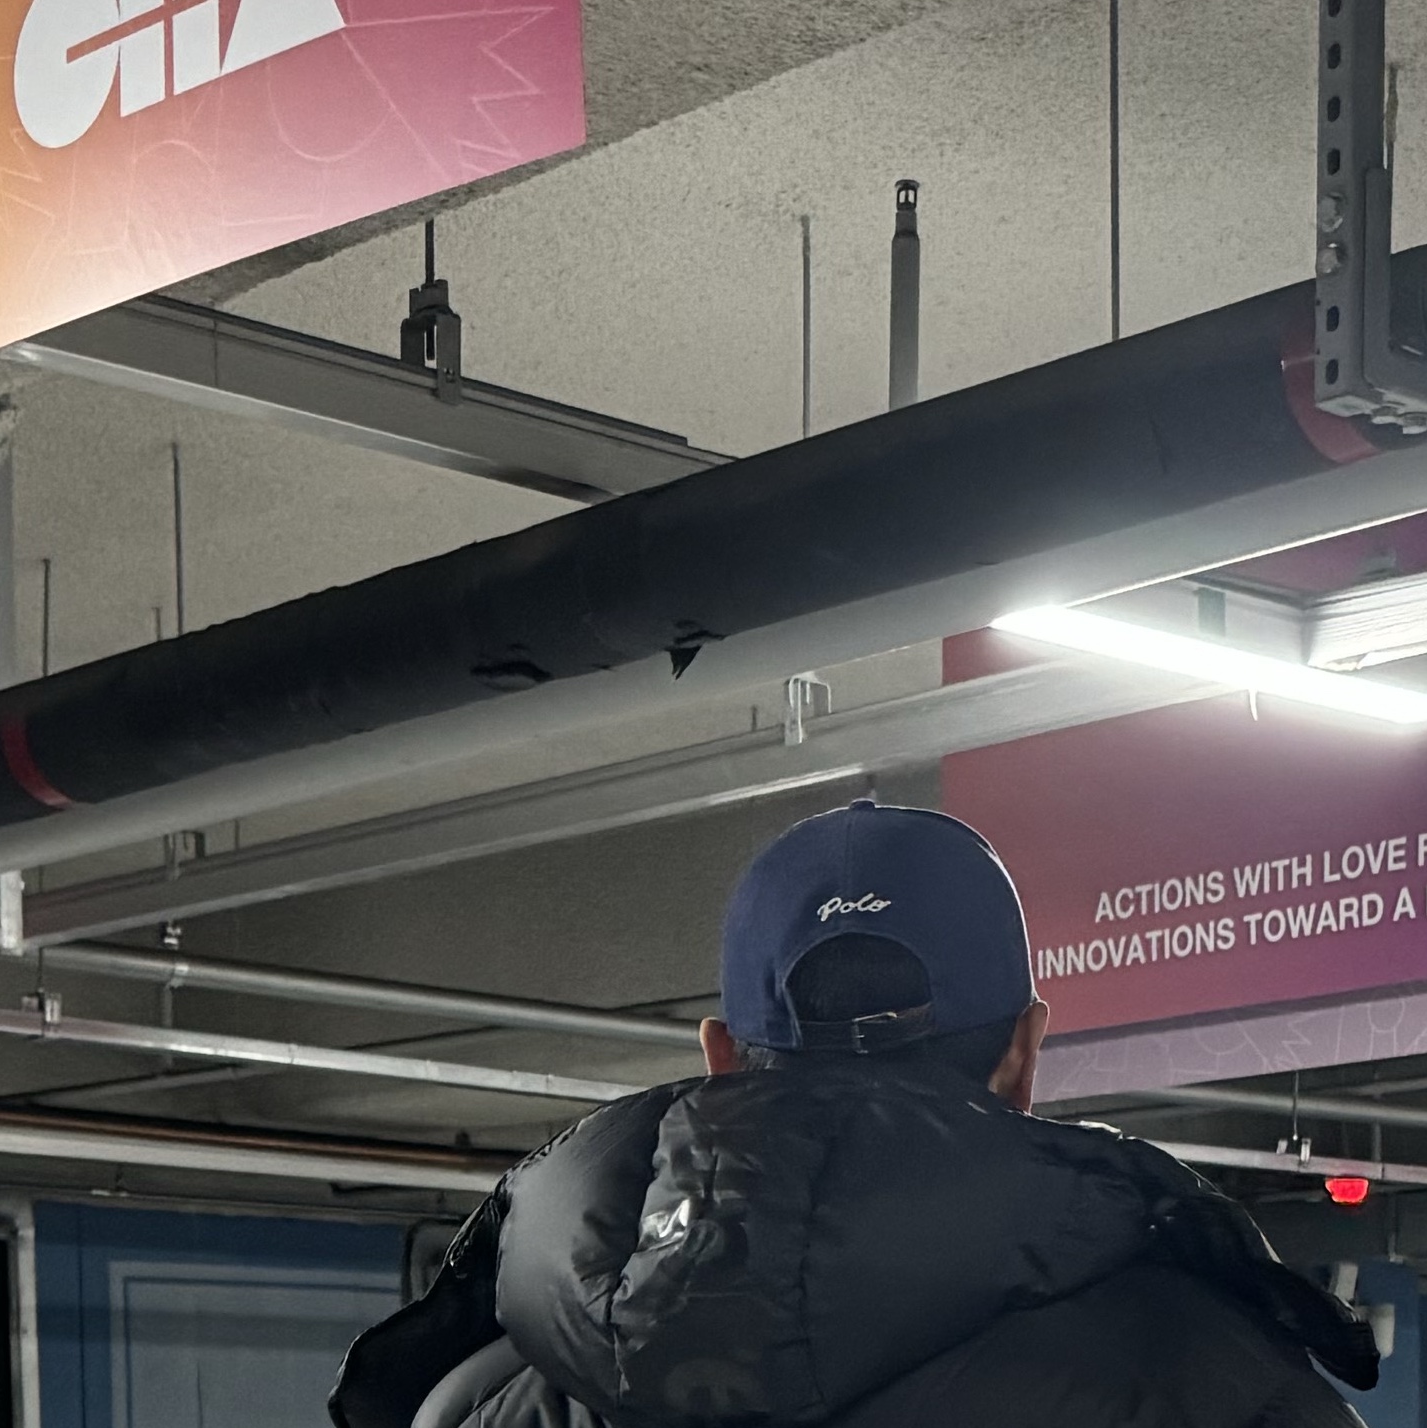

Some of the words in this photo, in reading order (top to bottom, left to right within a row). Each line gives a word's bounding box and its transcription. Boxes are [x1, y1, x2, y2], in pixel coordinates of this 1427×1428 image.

[817, 893, 891, 921] Polo
[1094, 871, 1225, 923] ACTIONS
[1233, 854, 1313, 898] WITH
[1323, 836, 1407, 883] LOVE
[1037, 917, 1235, 979] INNOVATIONS
[1243, 892, 1384, 945] TOWARD
[1392, 886, 1417, 922] A
